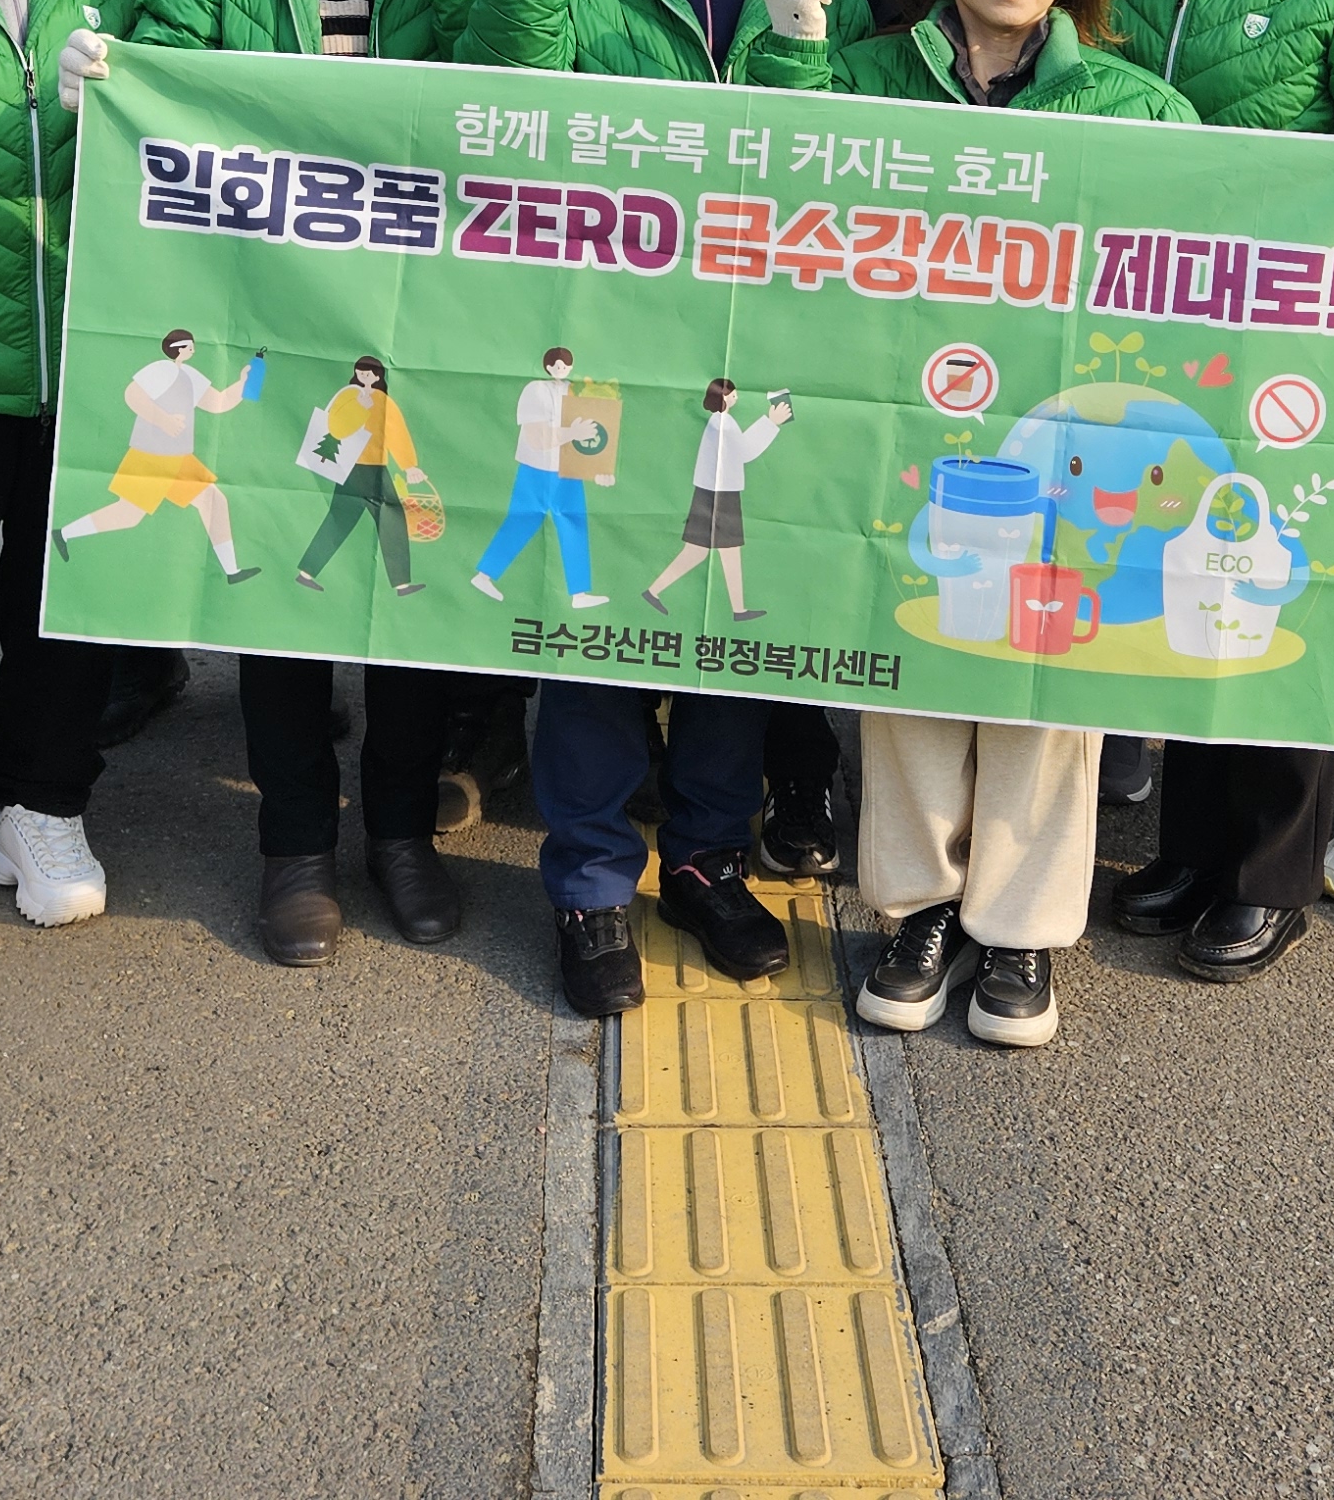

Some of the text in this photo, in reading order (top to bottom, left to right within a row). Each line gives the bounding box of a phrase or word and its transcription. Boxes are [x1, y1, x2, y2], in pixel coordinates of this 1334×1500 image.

[455, 104, 1049, 203] 함께 할수록 더 커지는 효과
[142, 143, 440, 250] 일회용품
[460, 180, 680, 270] ZERO
[699, 198, 1076, 305] 금수강산이
[1205, 551, 1253, 575] ECO
[511, 617, 902, 690] 금수강산면 행정복지센터
